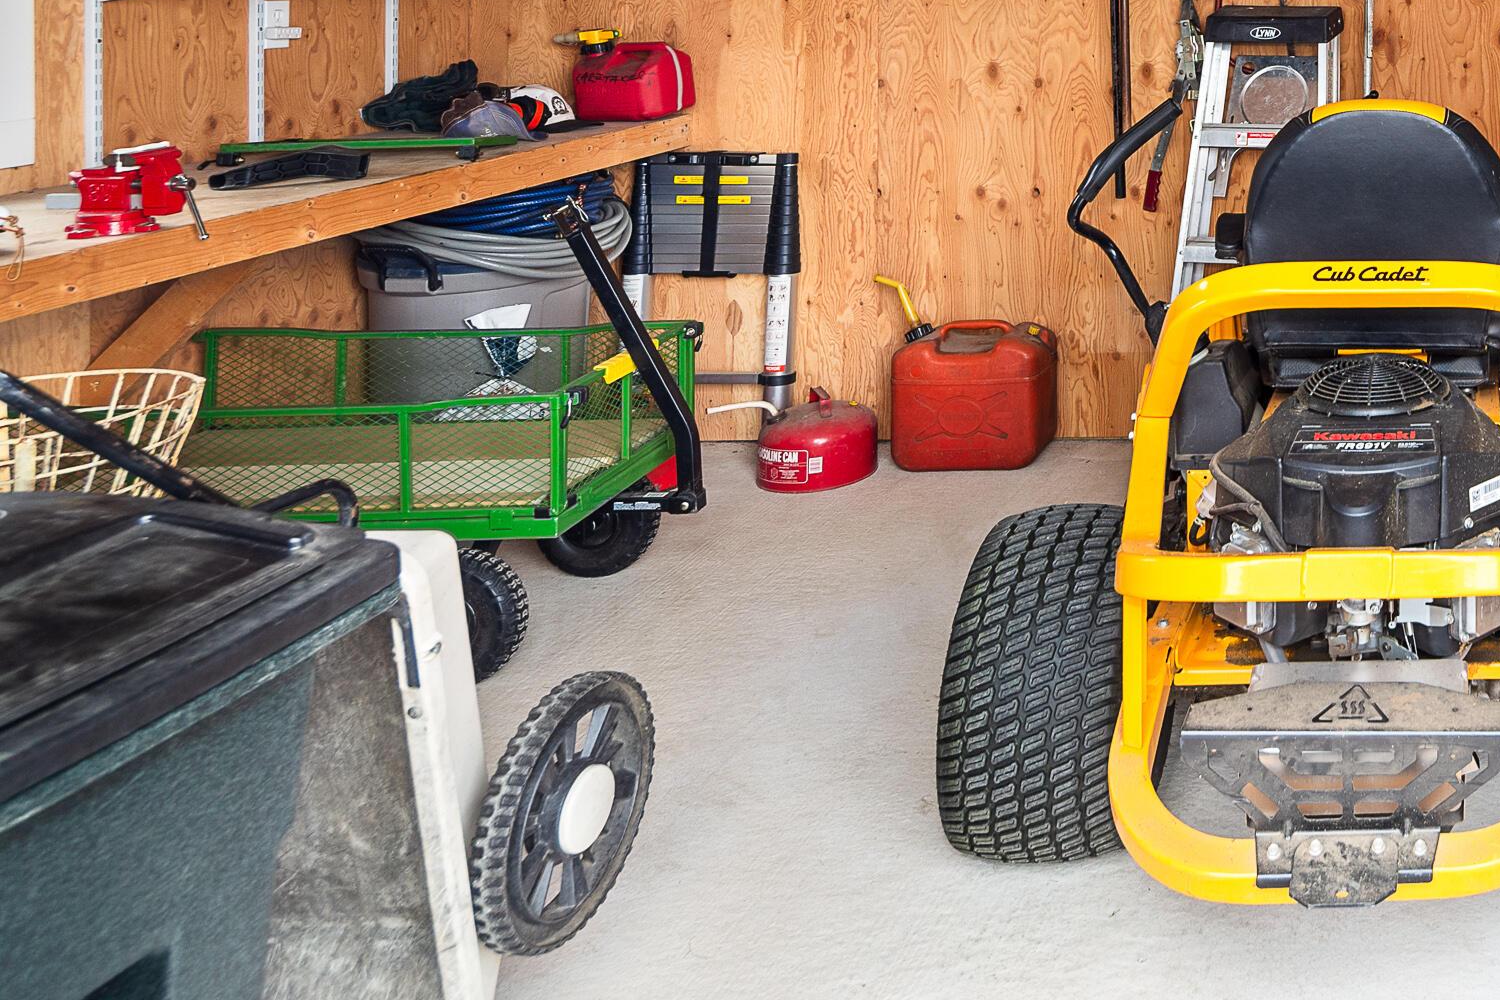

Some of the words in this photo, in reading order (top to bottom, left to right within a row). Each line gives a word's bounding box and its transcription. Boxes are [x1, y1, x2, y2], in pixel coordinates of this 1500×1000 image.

[1255, 29, 1276, 38] LYNN
[1312, 266, 1356, 281] Cub
[1358, 266, 1430, 281] Cadet
[1313, 430, 1416, 441] Kawasaki
[782, 450, 799, 463] CAN
